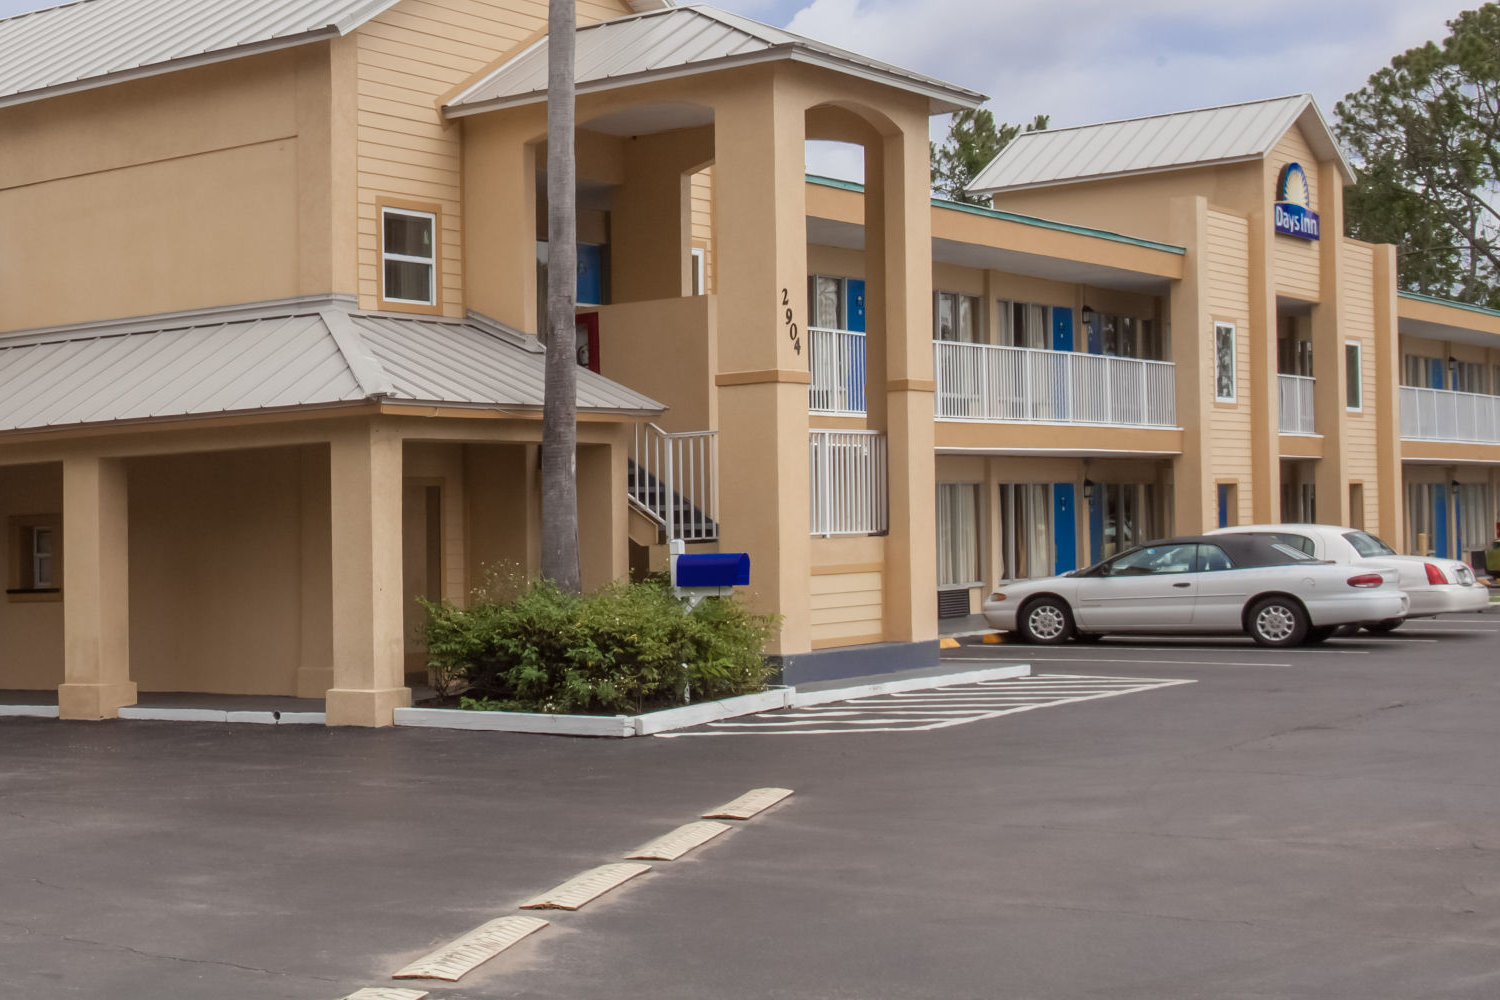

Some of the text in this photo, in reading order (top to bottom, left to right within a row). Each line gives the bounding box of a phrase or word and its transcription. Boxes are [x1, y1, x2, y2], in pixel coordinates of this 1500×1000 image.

[1275, 205, 1317, 235] Days Inn
[781, 287, 801, 356] 2904
